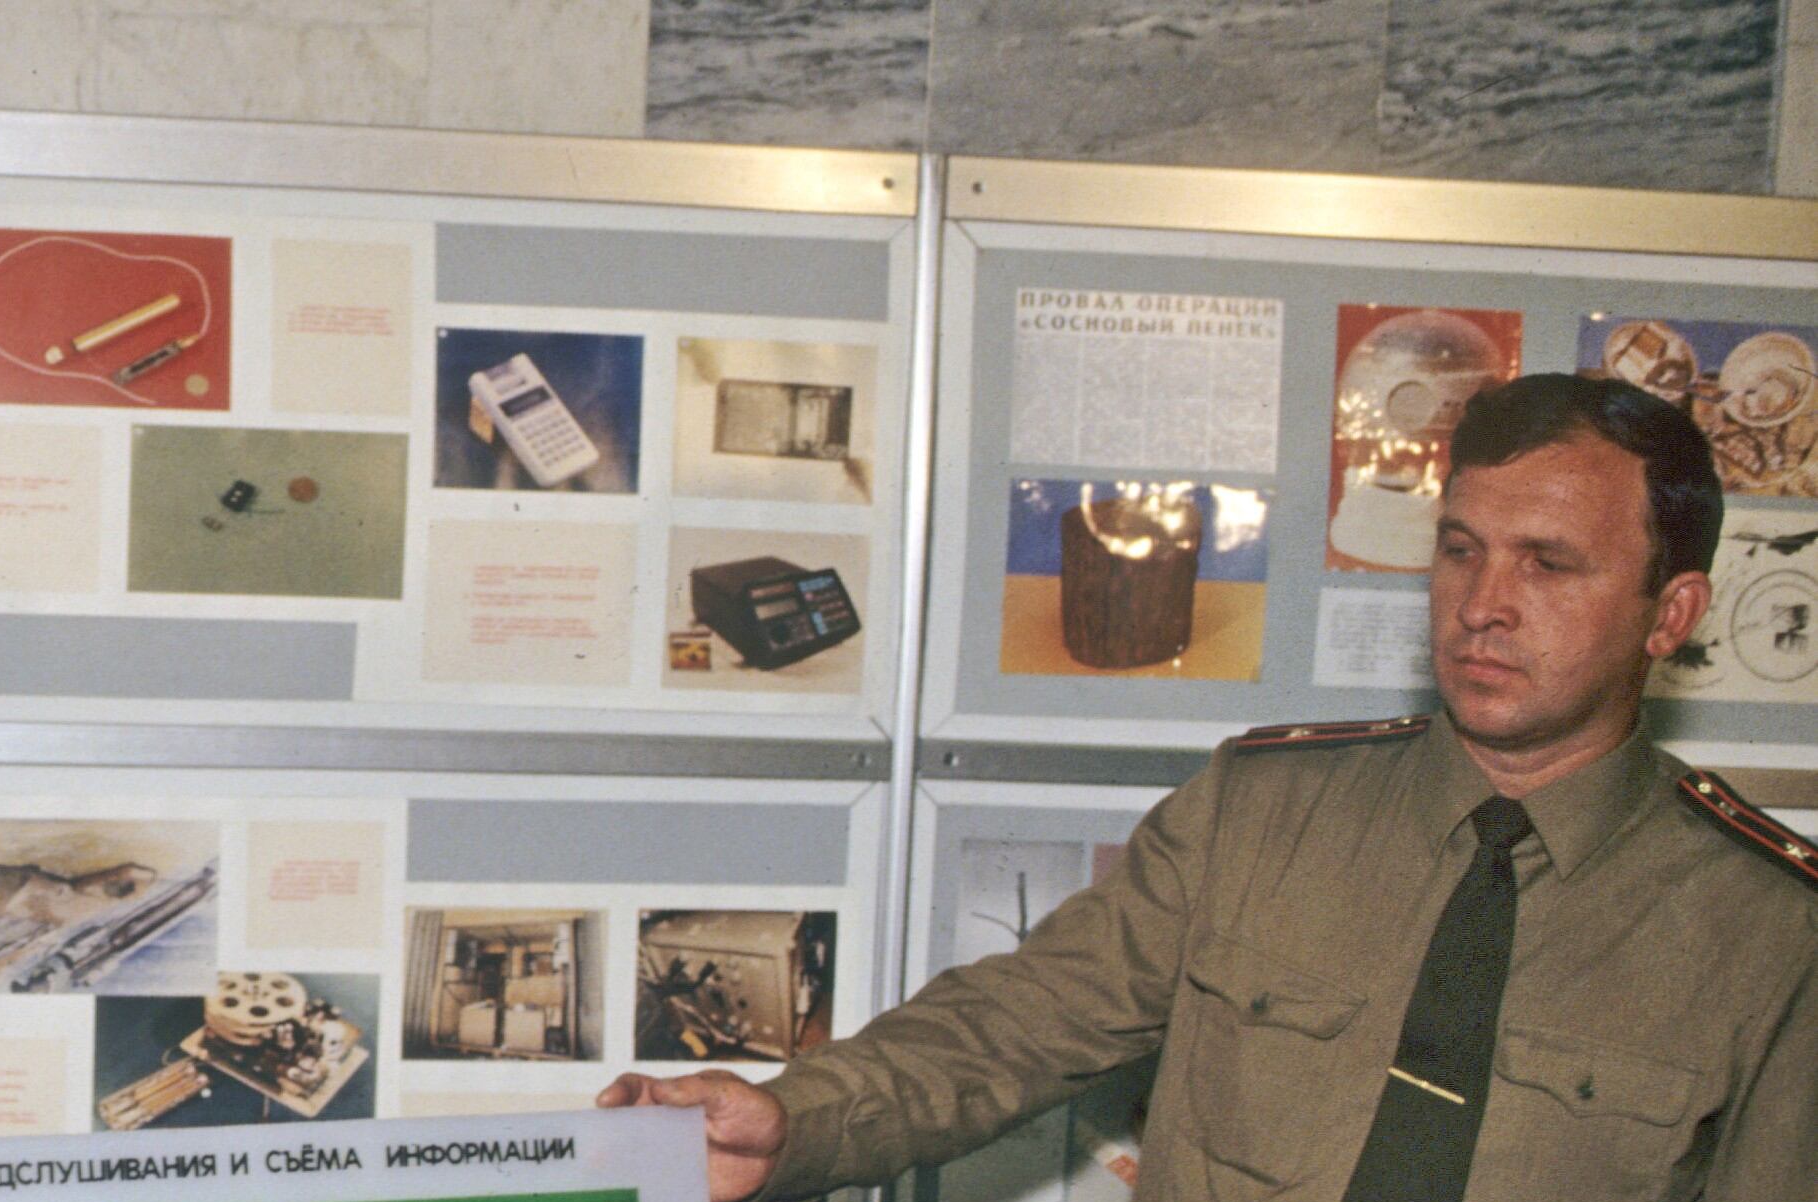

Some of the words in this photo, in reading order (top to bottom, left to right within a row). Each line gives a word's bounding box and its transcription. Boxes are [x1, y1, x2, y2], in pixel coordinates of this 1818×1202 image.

[1019, 291, 1125, 313] ПРОВАЛ
[1136, 295, 1277, 318] ОПЕРАЦИИ
[230, 1151, 249, 1175] И
[265, 1142, 363, 1174] СЪЁМА
[386, 1136, 575, 1168] ИНФОРМАЦИИ
